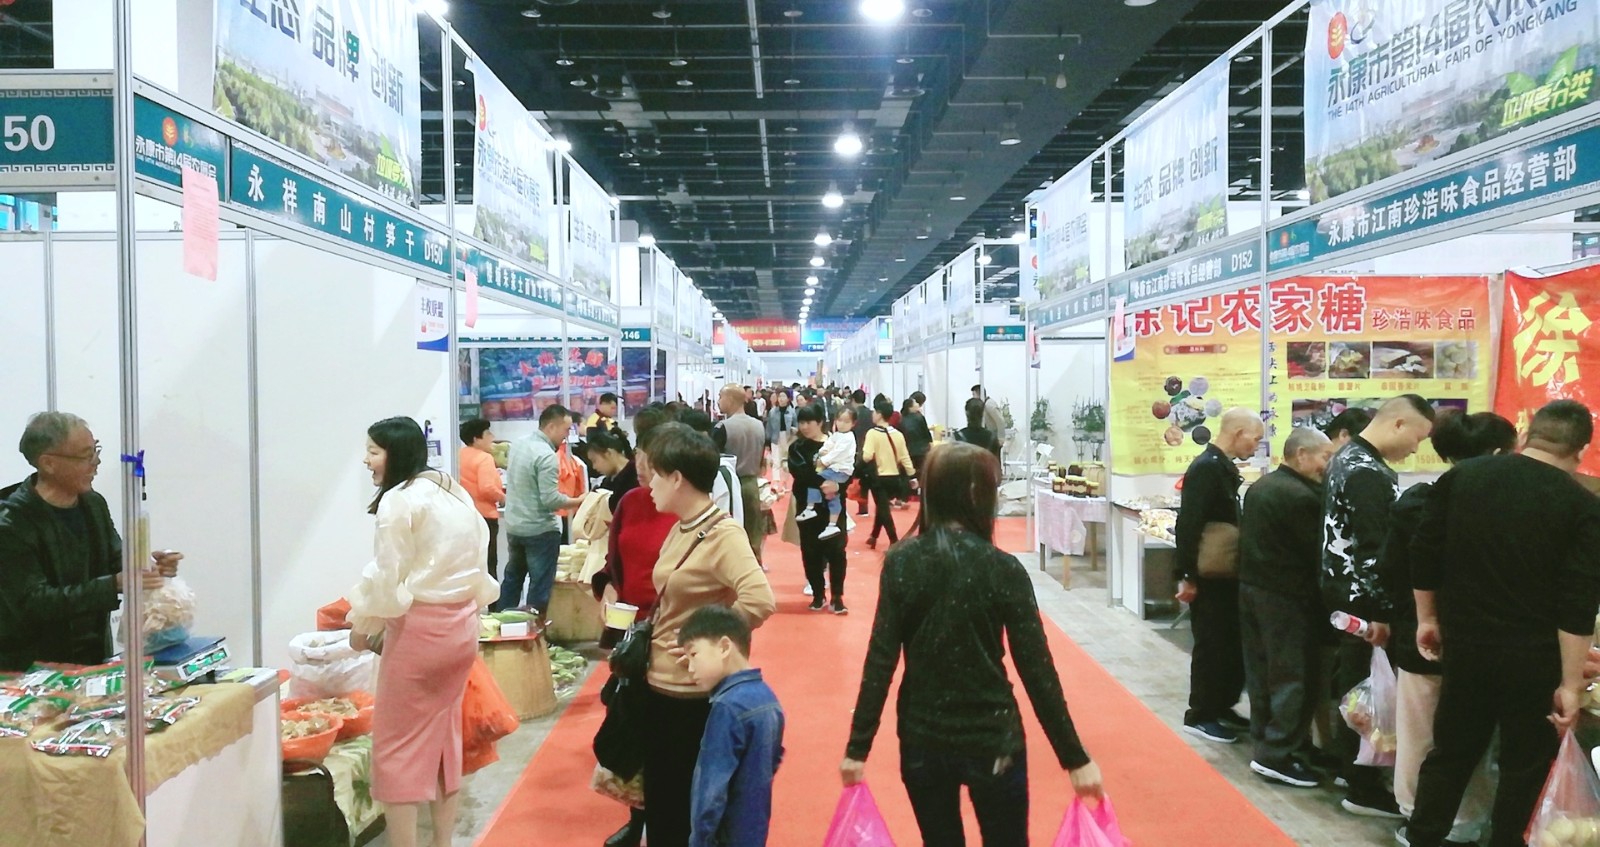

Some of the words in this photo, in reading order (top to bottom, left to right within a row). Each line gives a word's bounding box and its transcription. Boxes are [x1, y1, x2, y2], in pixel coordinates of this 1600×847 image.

[313, 5, 360, 83] 品牌
[370, 47, 404, 117] 创新
[1328, 106, 1343, 121] THE
[1368, 61, 1441, 105] AGRICULTURAL
[1445, 44, 1471, 69] FAIR
[1475, 34, 1493, 53] OF
[1498, 0, 1578, 43] YONGKANG
[1501, 67, 1595, 128] 垃圾要分类
[3, 114, 56, 152] 50
[1159, 156, 1184, 198] 品牌
[1190, 141, 1217, 181] 创新
[1328, 143, 1578, 247] 永康市江南珍浩味食品经营部
[247, 163, 415, 256] 永祥南山村笋干
[423, 238, 444, 266] D150
[1231, 249, 1253, 272] D152
[1372, 308, 1477, 332] 珍浩味食品
